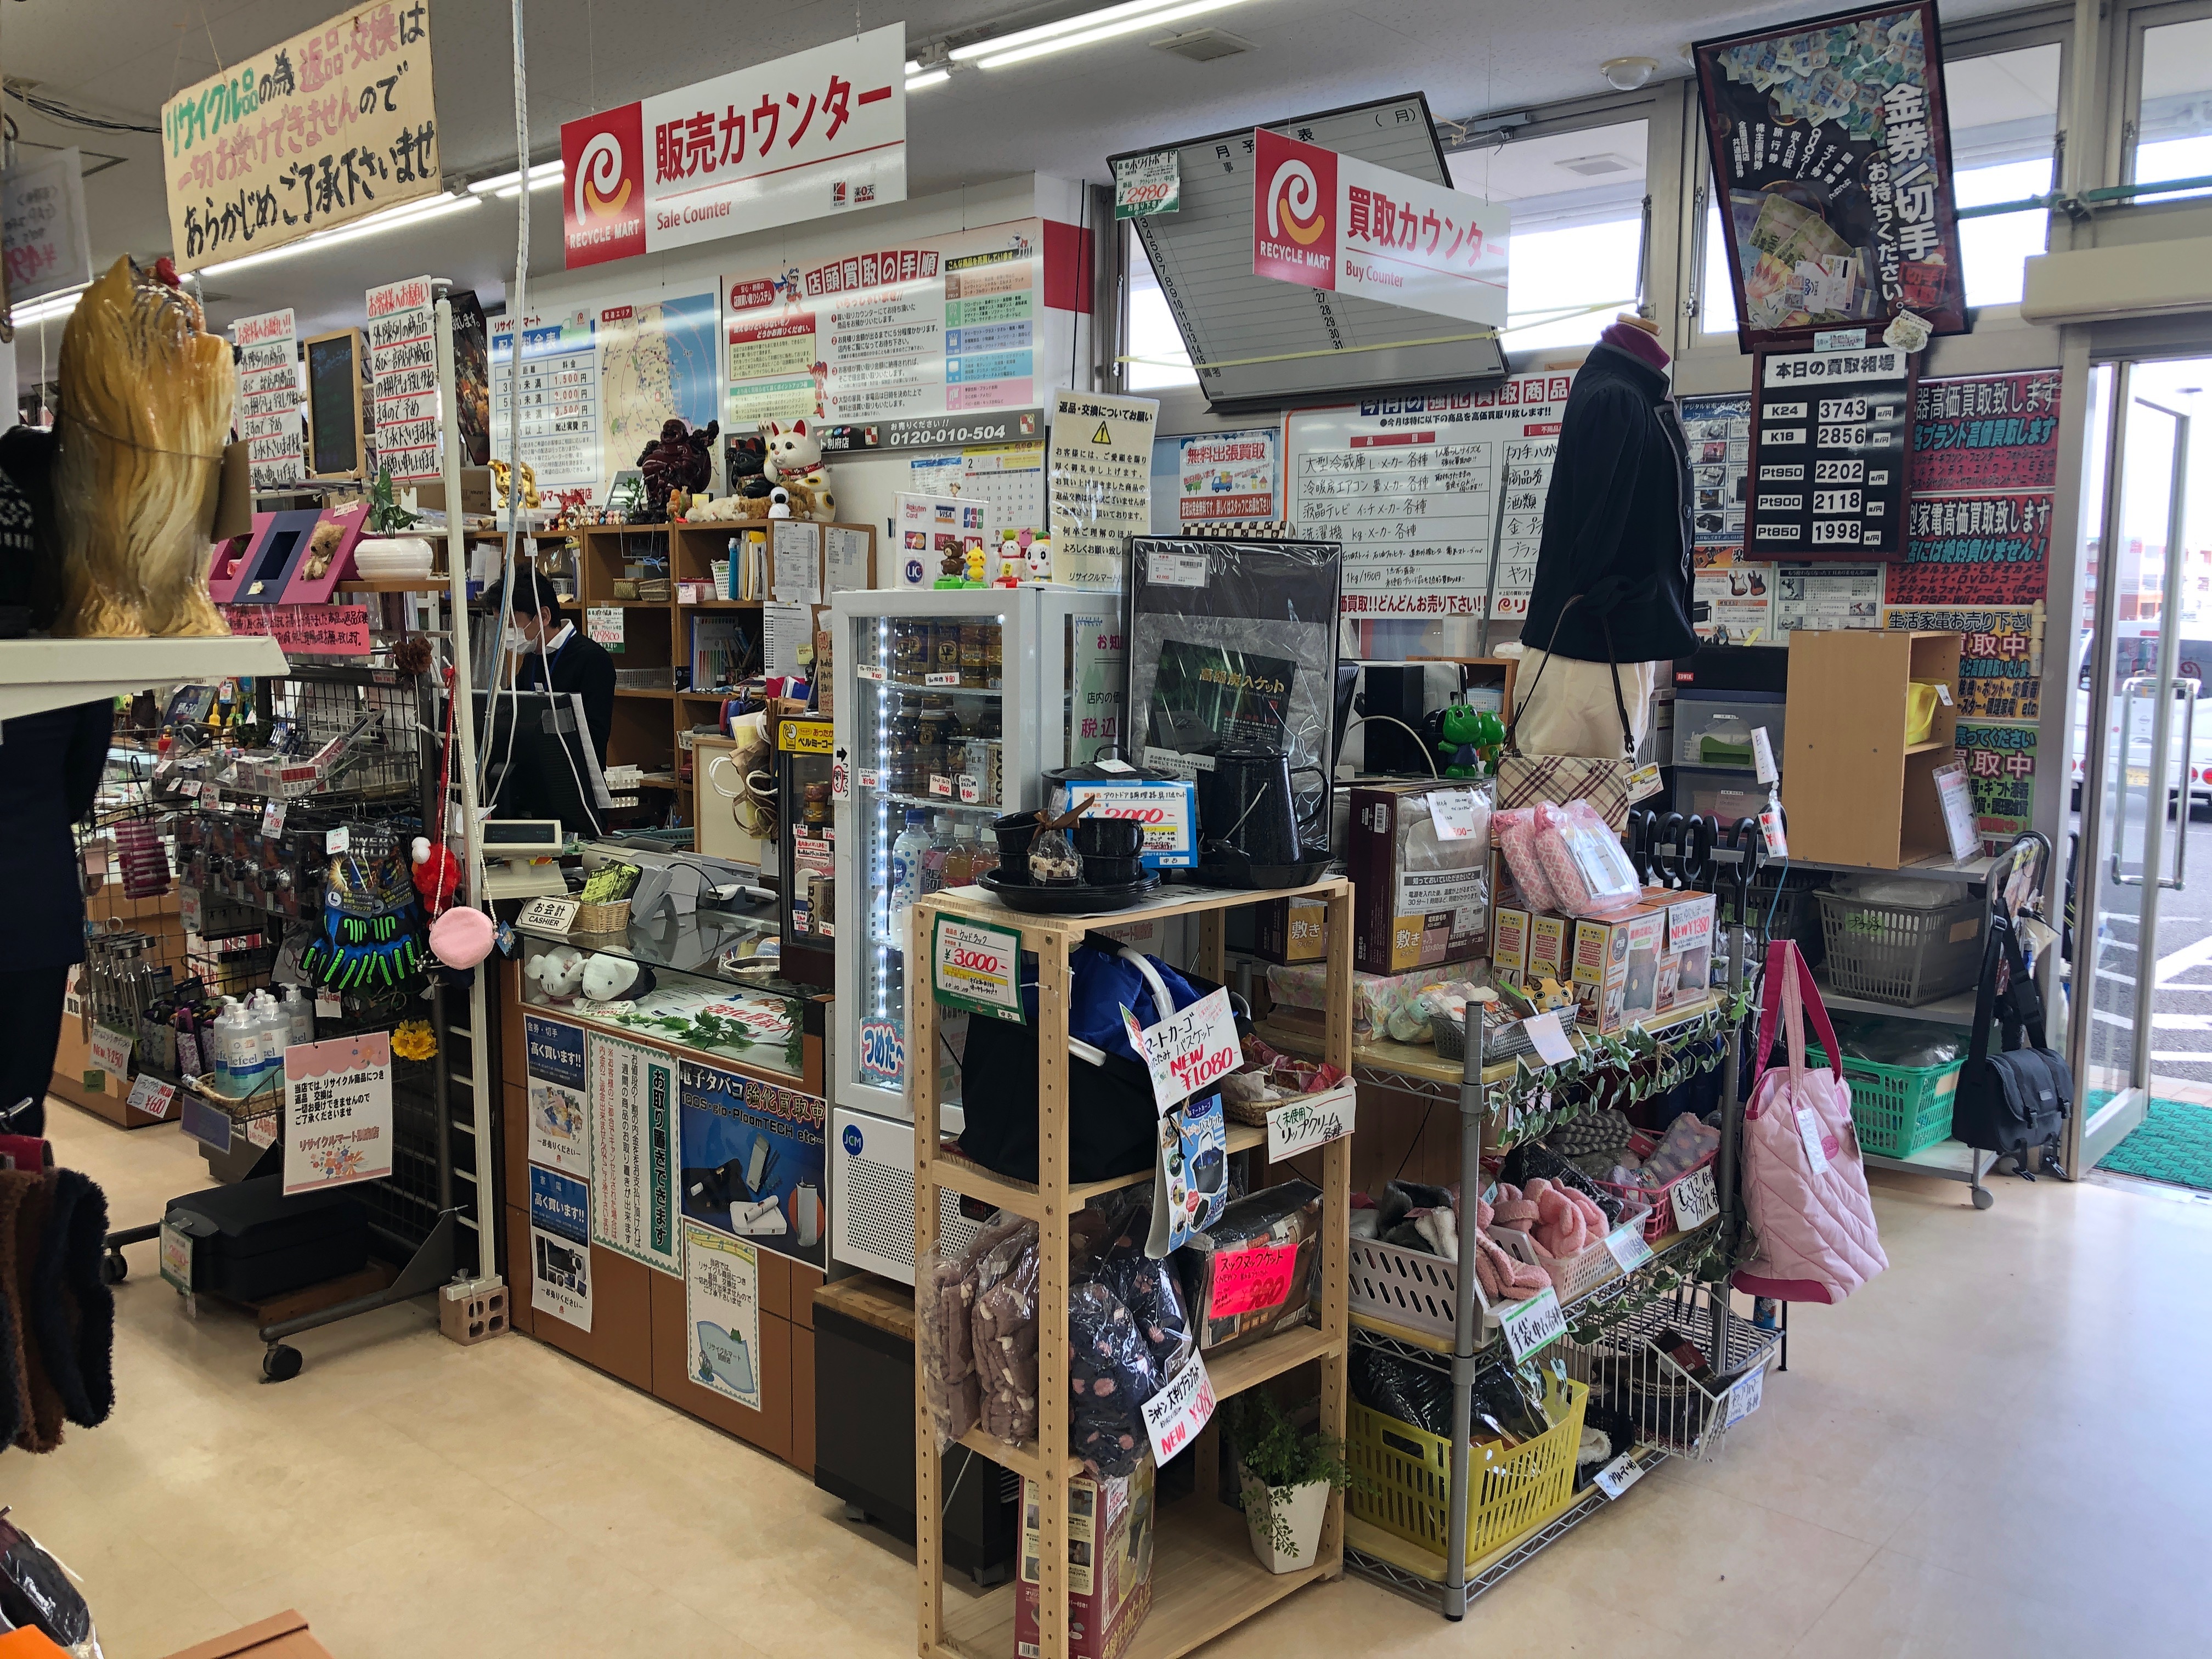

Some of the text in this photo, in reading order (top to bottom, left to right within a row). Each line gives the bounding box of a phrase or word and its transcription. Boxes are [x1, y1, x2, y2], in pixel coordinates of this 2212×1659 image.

[167, 48, 295, 157] リサイクル品の為
[178, 61, 408, 190] 一切お受けできませんので
[656, 75, 892, 185] 販売カウンター
[1216, 144, 1232, 159] 月
[185, 121, 436, 258] あらかじめご了承下さいませ
[657, 199, 732, 231] Sale Counter
[1140, 218, 1148, 228] 3
[569, 219, 640, 249] RECYCLE MART
[1347, 184, 1505, 267] 買取カウンター
[1869, 162, 1905, 309] お持ちください。
[1260, 242, 1330, 270] RECYCLE MART
[807, 253, 938, 295] 店頭買取の手順
[1165, 277, 1173, 286] 8
[1346, 259, 1404, 288] Buy Counter
[369, 282, 428, 317] お客様へお願い
[1173, 300, 1183, 309] 10
[1316, 292, 1325, 304] 27
[1183, 323, 1193, 332] 12
[1324, 316, 1335, 327] 29
[1197, 355, 1206, 365] 15
[1776, 354, 1894, 380] 本日の買取相場
[1059, 400, 1153, 422] 返品・交換についてお願い
[1771, 405, 1798, 416] K24
[1820, 399, 1866, 418] 3743
[890, 424, 1006, 446] 0120-010-504
[1770, 431, 1795, 442] K18
[1819, 426, 1865, 444] 2856
[1188, 442, 1265, 464] 無料出張買取
[1407, 452, 1429, 468] 各種
[968, 458, 973, 469] 2
[1762, 467, 1803, 479] Pt950
[1817, 462, 1863, 479] 2202
[1408, 475, 1429, 492] 各種
[906, 504, 926, 512] Rakuten
[1403, 498, 1427, 515] 各種
[1759, 496, 1801, 507] Pt900
[1815, 493, 1860, 511] 2118
[964, 514, 984, 522] JCB
[1302, 526, 1343, 540] 洗濯機
[1395, 523, 1417, 539] 各種
[1757, 527, 1798, 537] Pt850
[1815, 523, 1860, 541] 1998
[907, 566, 922, 577] UC
[347, 837, 388, 847] OWER
[1413, 873, 1475, 884] 知っておいていただきたいこと
[534, 901, 565, 918] お会計
[528, 916, 560, 928] CASHIER
[1291, 919, 1322, 940] 敷き
[1672, 916, 1709, 939] NEW ¥1380
[960, 929, 987, 944] ウッドラック
[1396, 929, 1420, 949] 敷き
[945, 949, 951, 960] ¥
[531, 1042, 581, 1067] 高く買います!!
[1170, 1044, 1204, 1078] NEW
[295, 1093, 370, 1113] 一切お受けできませんので
[679, 1063, 825, 1129] 電子タバコ 強化買取中
[145, 1097, 165, 1114] ¥600
[295, 1107, 352, 1125] ご了承くださいませ
[653, 1070, 667, 1245] お取り置きできます
[534, 1192, 585, 1224] 高く買います!!
[1161, 1421, 1186, 1455] NEW
